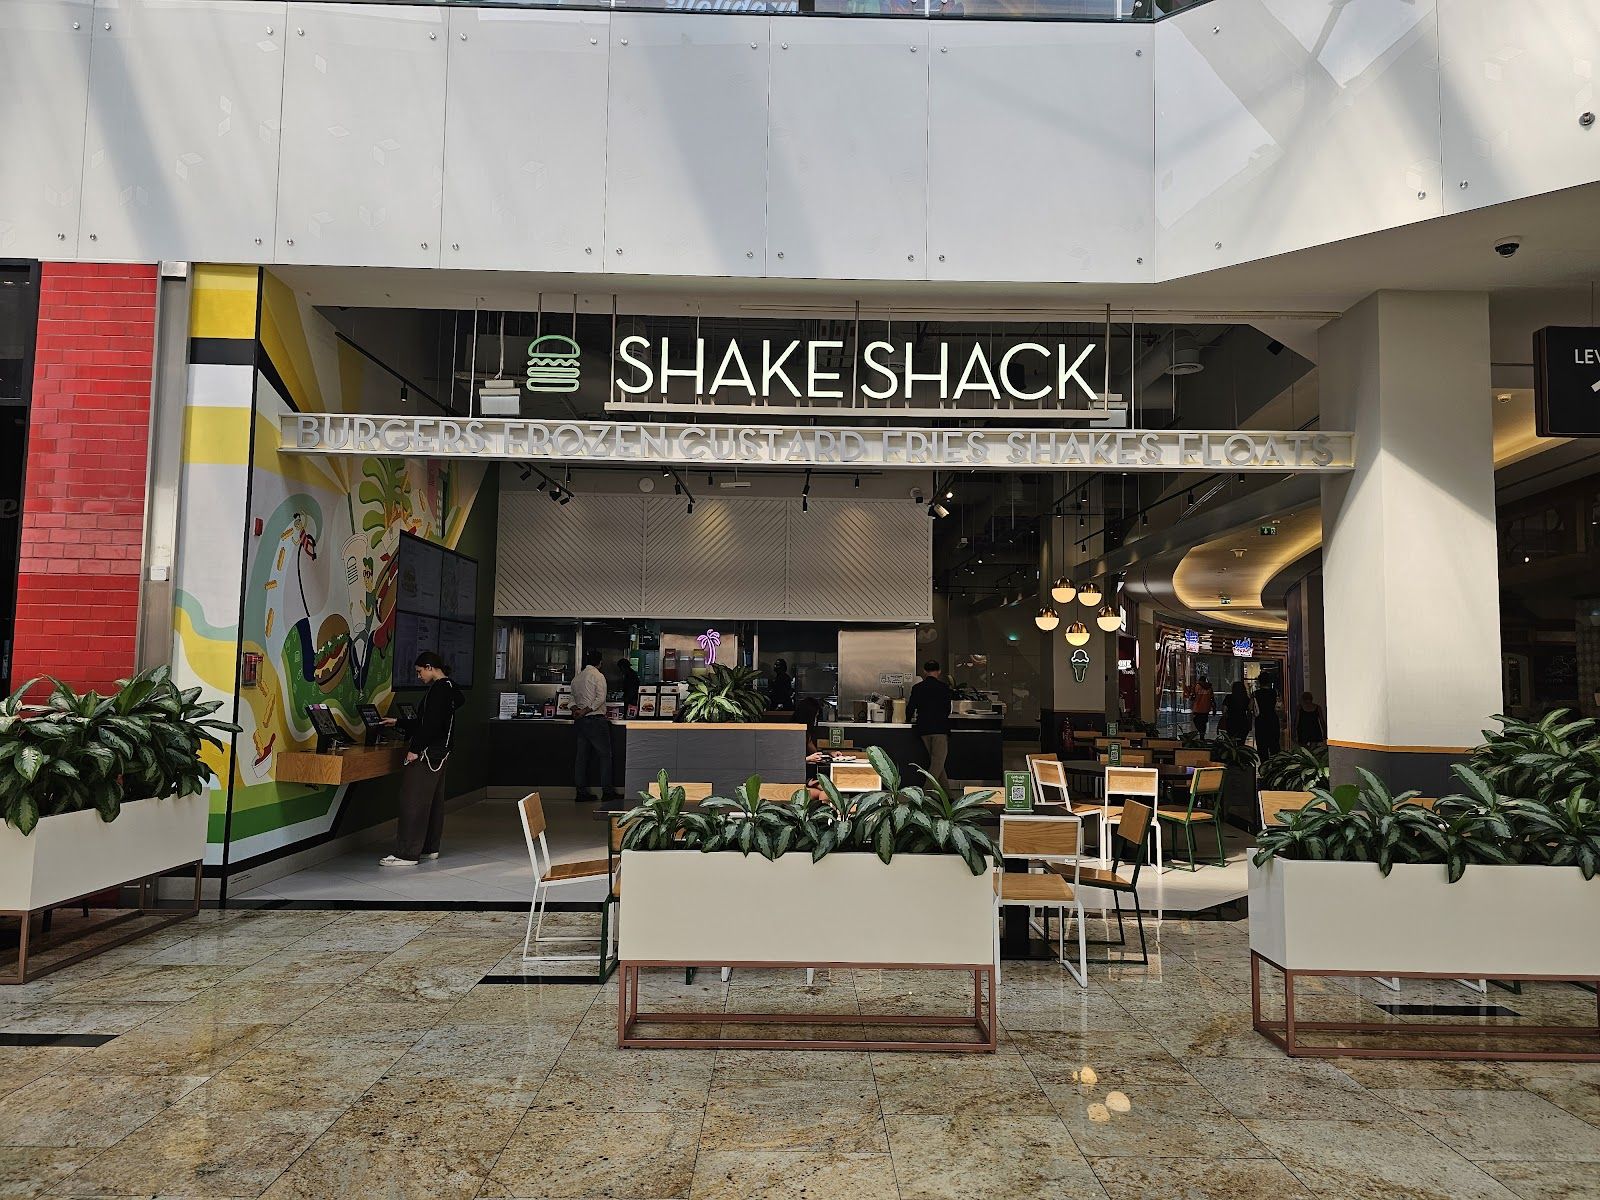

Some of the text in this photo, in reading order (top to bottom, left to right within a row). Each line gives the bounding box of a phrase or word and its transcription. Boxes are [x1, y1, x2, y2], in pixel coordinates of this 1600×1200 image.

[615, 335, 1098, 400] SHAKE SHACK
[296, 416, 1334, 467] BURGERS FROZEN CUSTARD FRIES SHAKES FLOATS
